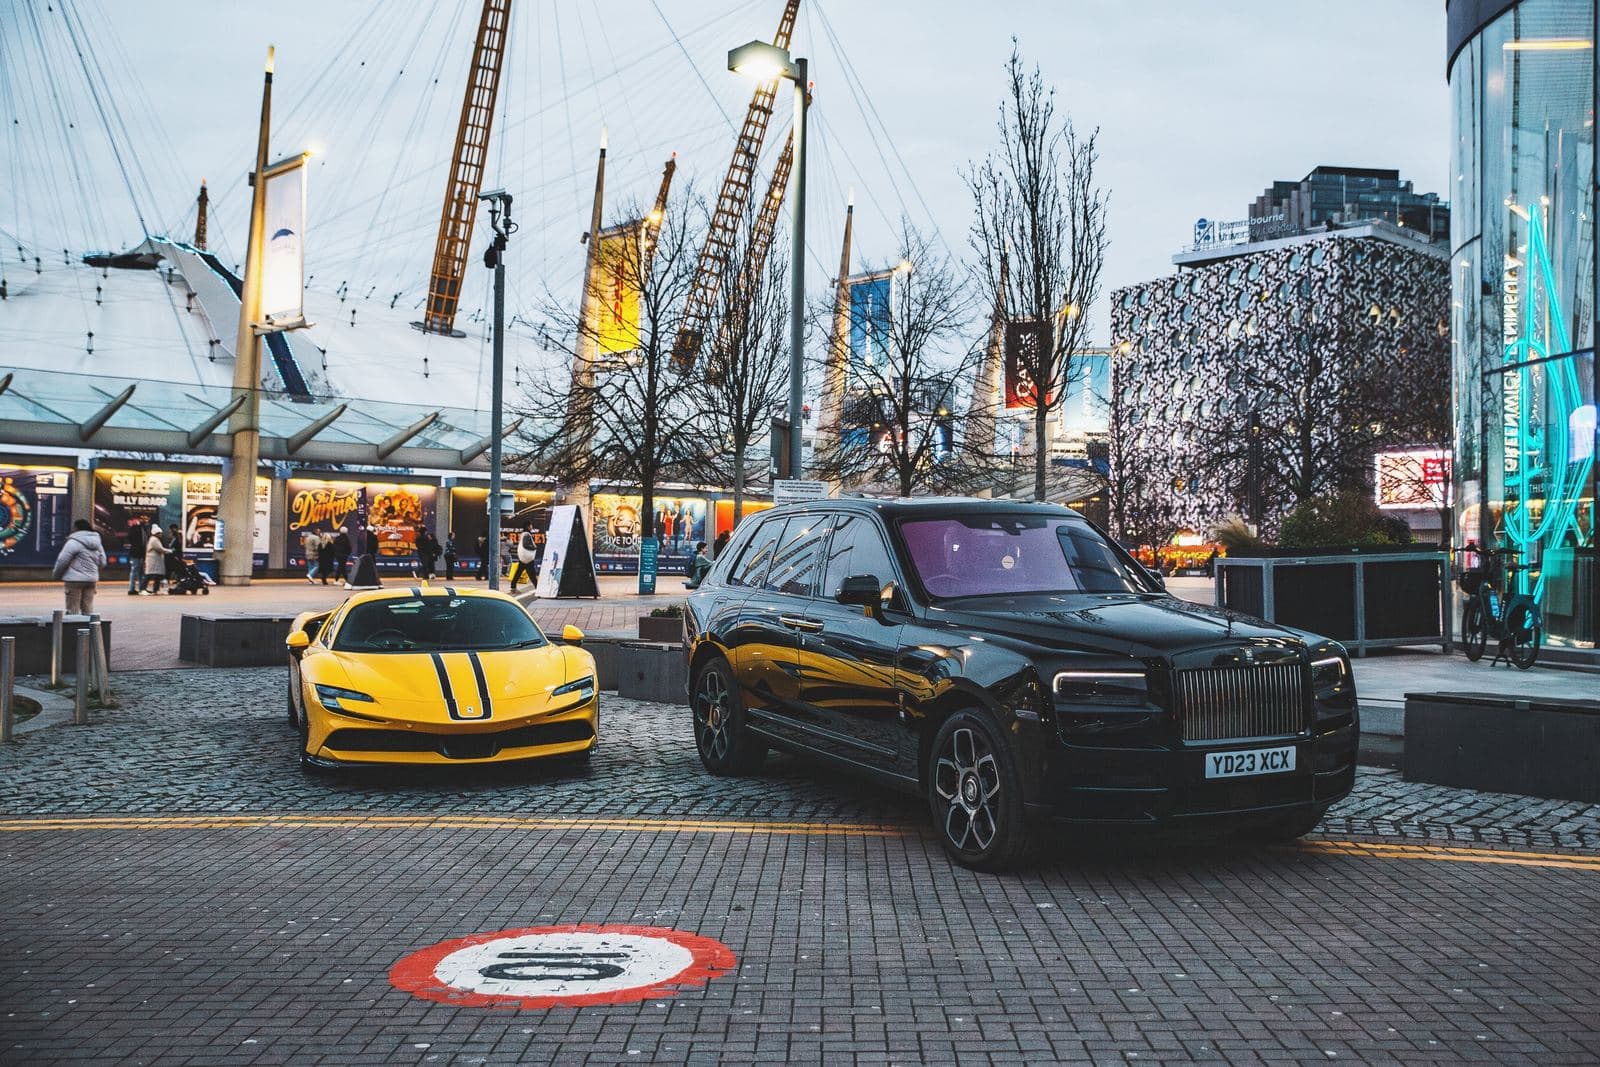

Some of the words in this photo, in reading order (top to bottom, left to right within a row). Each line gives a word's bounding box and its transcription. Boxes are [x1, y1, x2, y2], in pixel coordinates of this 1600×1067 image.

[604, 536, 621, 545] LIVE
[1213, 753, 1256, 775] YD23
[1260, 745, 1289, 771] XCX
